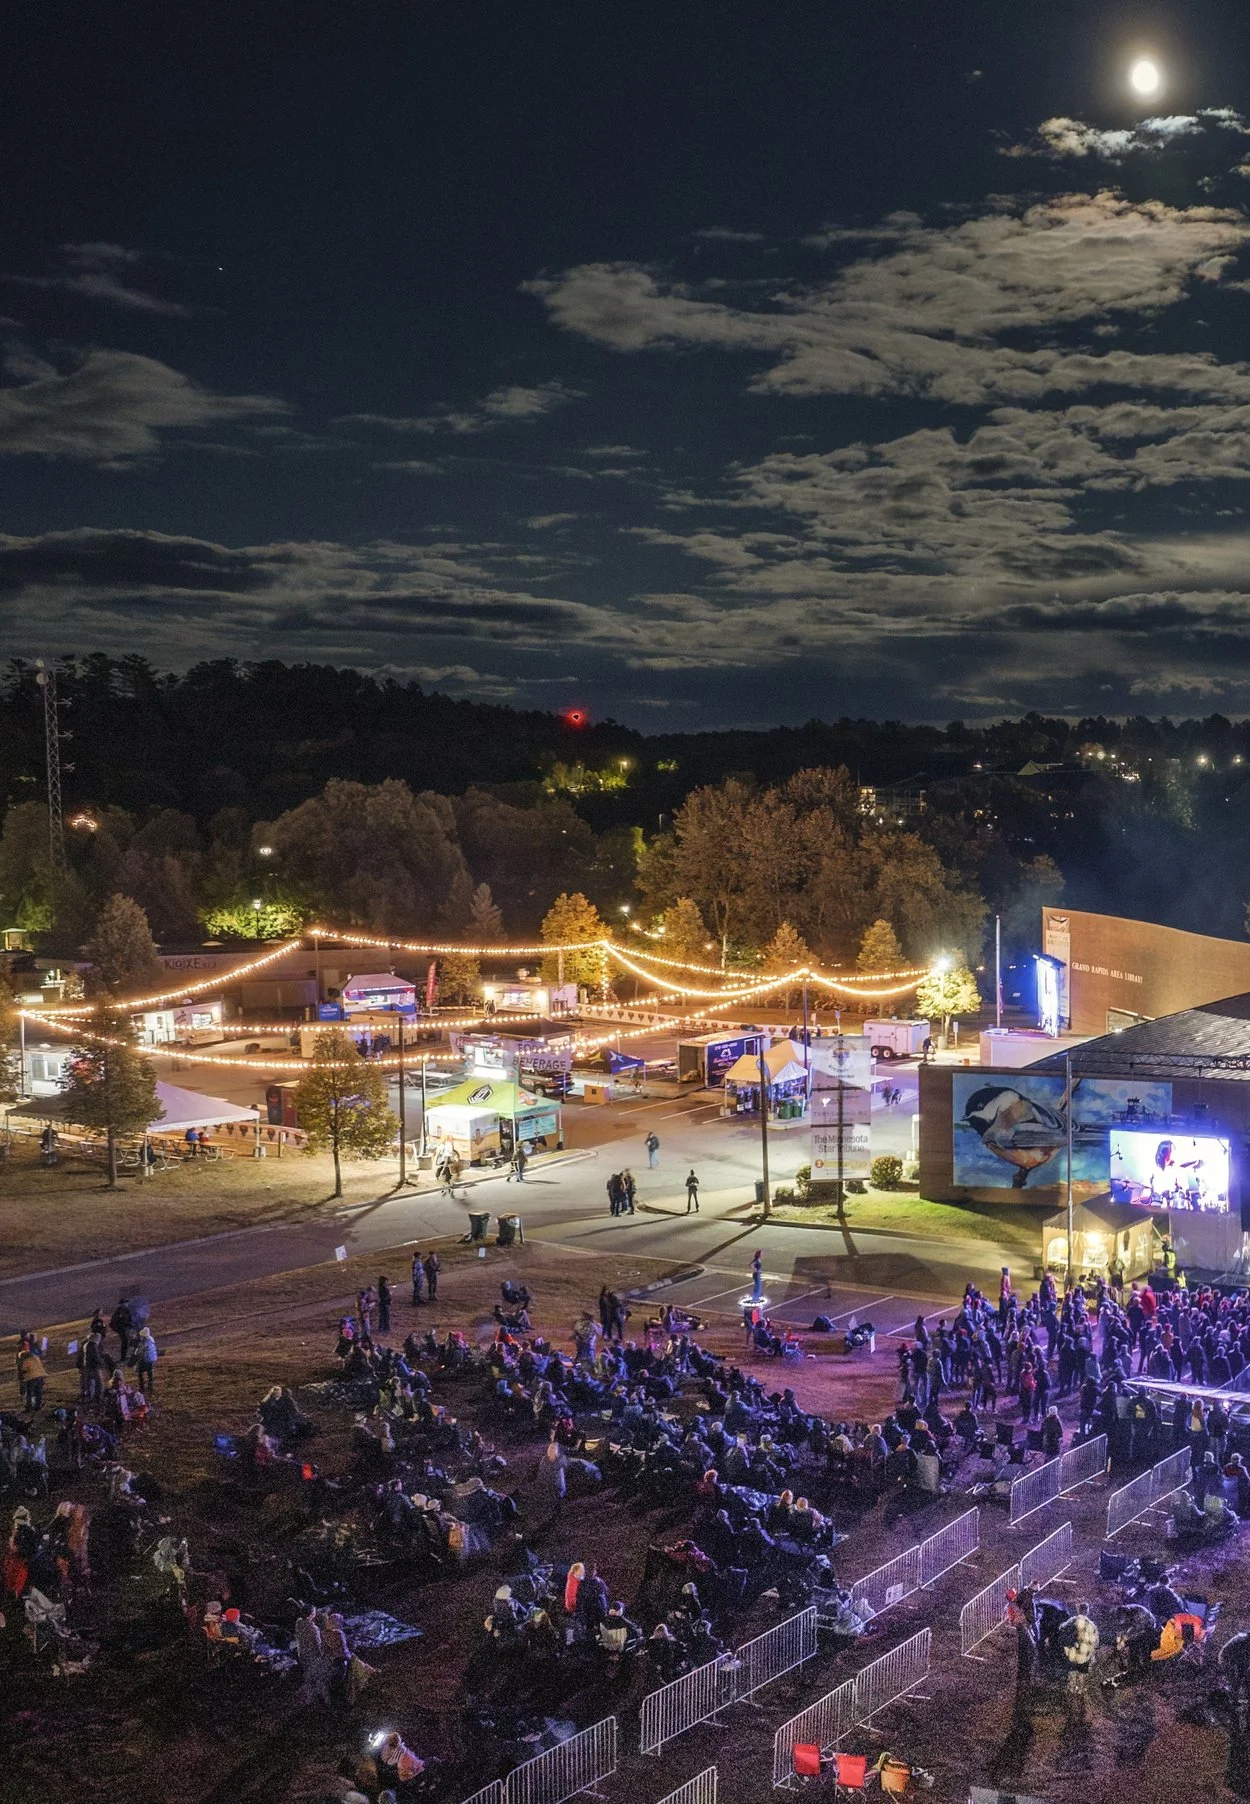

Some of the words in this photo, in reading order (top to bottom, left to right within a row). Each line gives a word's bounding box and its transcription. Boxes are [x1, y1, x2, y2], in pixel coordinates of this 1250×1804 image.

[1072, 962, 1090, 972] GRAND
[1091, 966, 1109, 976] RAPIDS
[1110, 970, 1123, 980] AREA
[1124, 972, 1143, 984] LIBRARY
[512, 1056, 566, 1070] BEVERAGE
[814, 1134, 827, 1144] The
[828, 1134, 868, 1143] Minesota
[818, 1143, 835, 1153] Star
[836, 1144, 865, 1153] ibune
